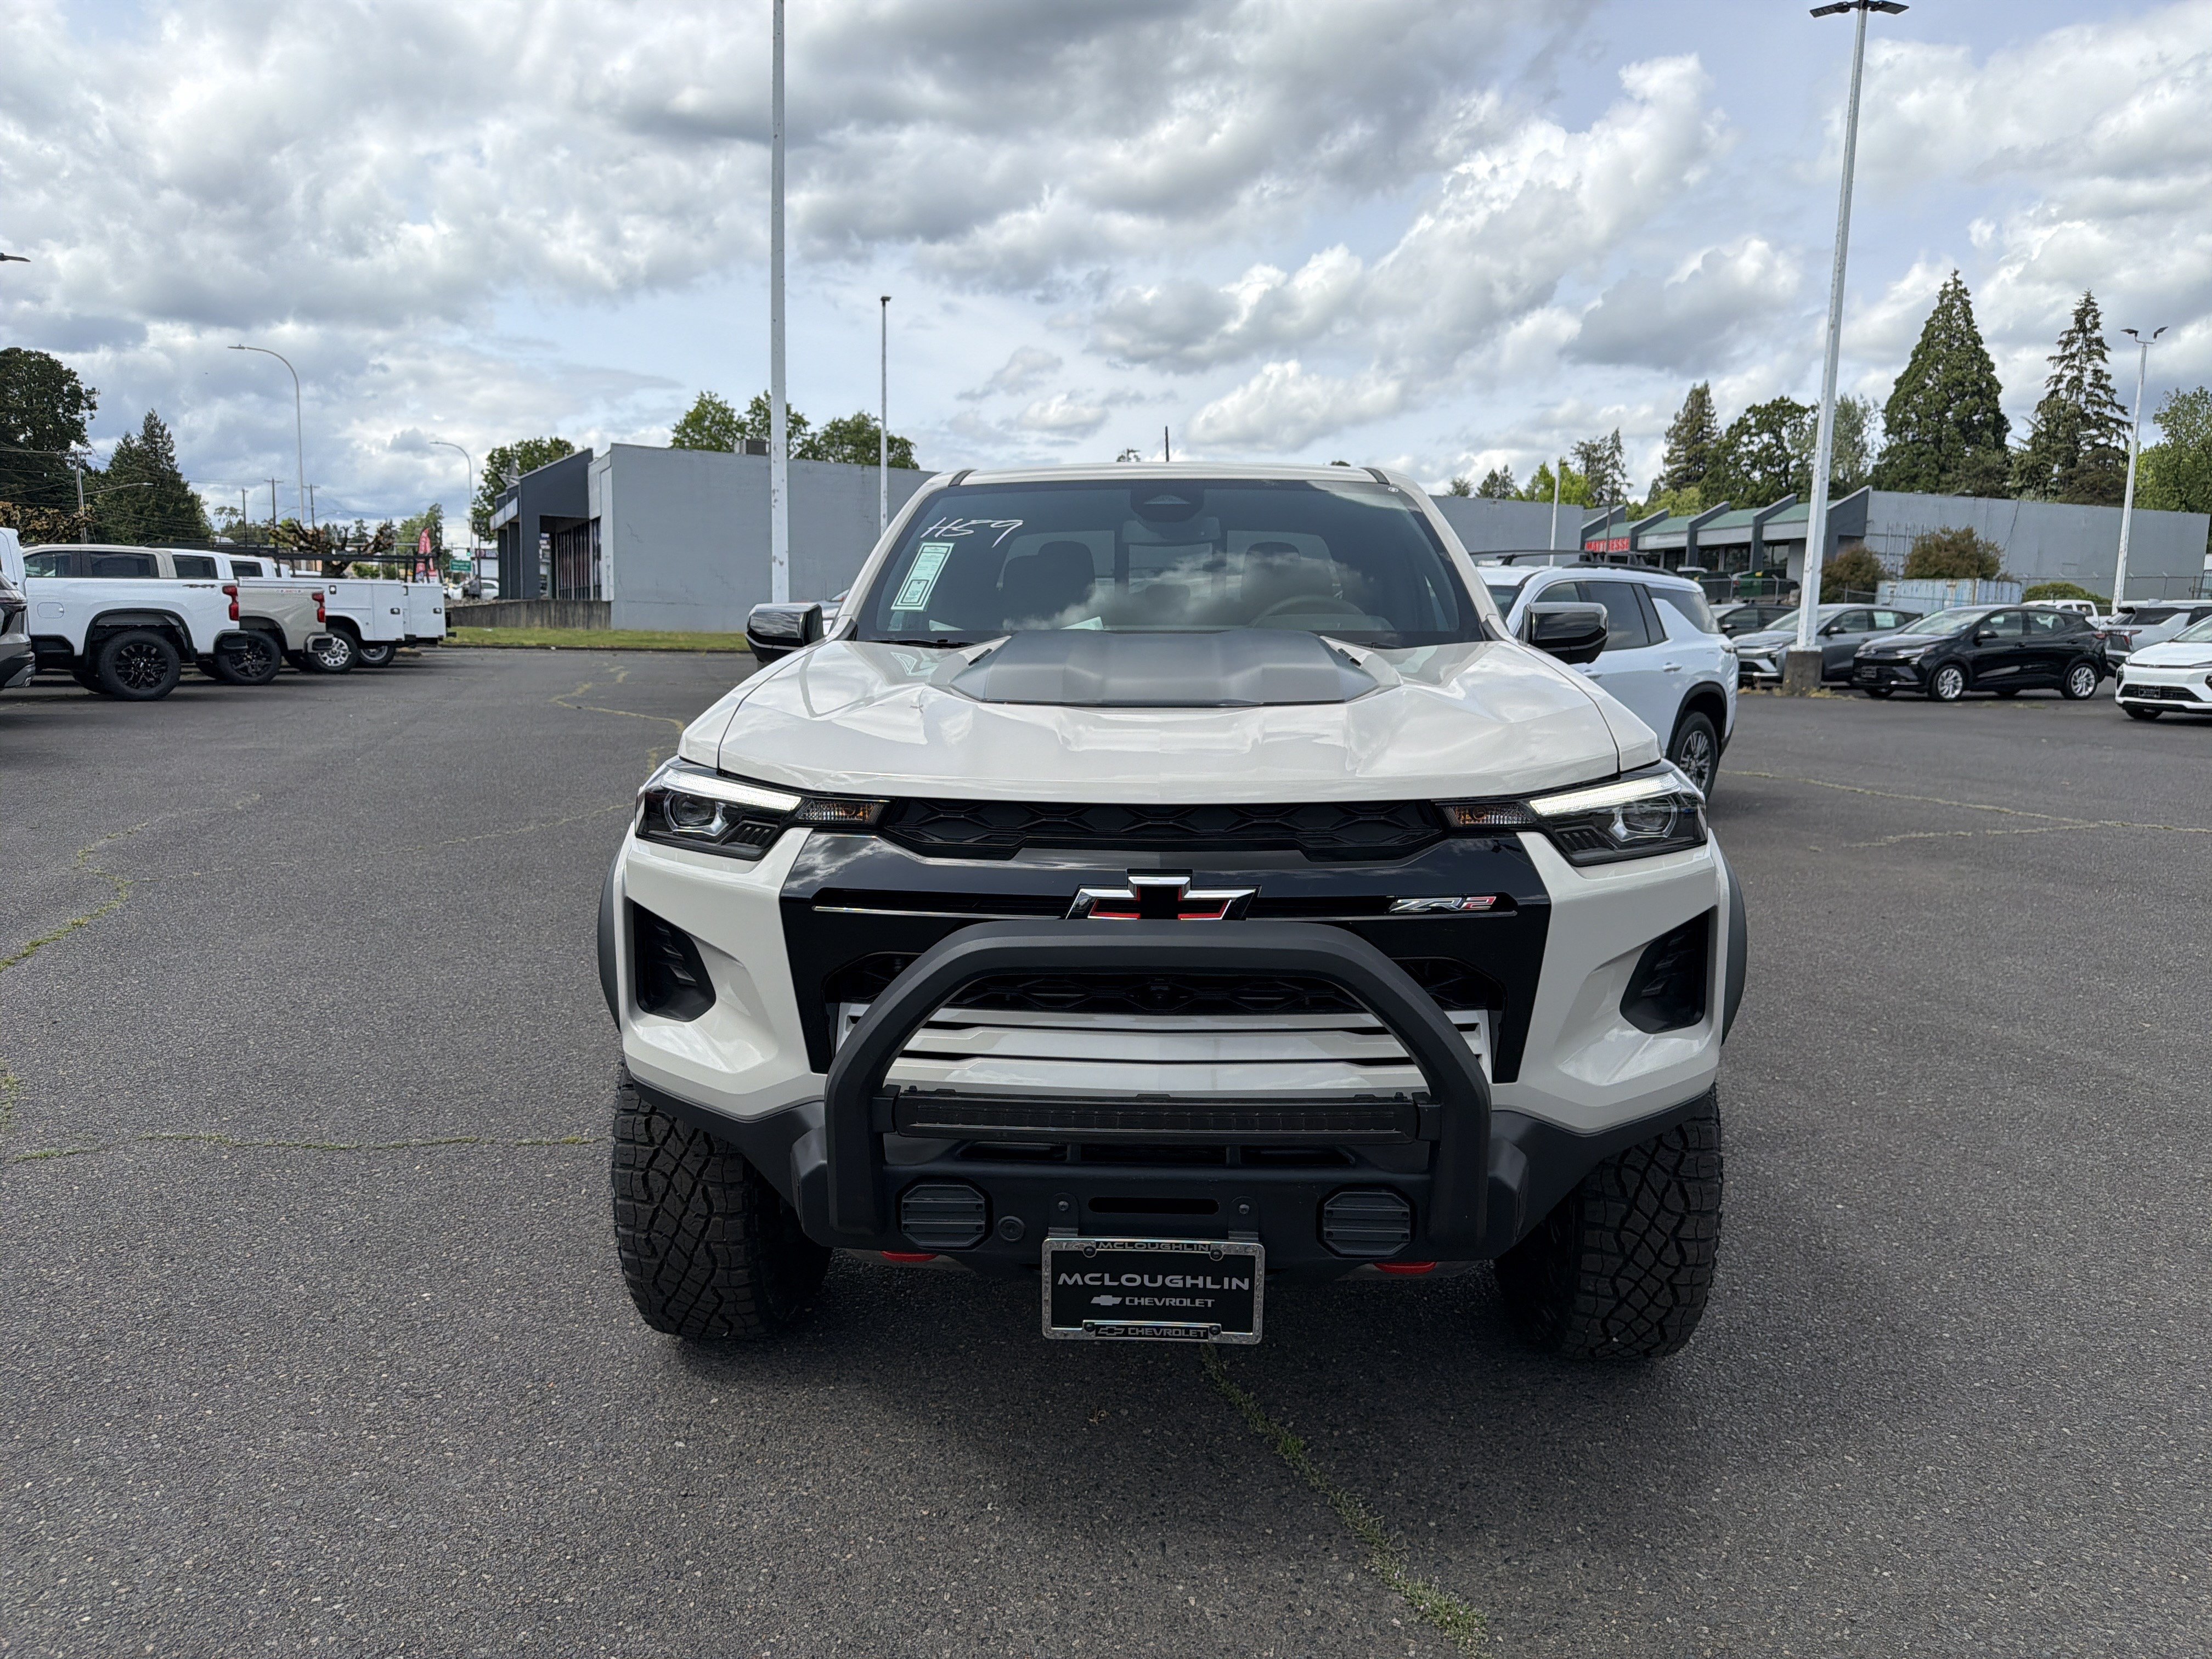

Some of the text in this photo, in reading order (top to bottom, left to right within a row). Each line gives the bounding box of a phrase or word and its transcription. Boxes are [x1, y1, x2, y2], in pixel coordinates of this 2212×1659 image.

[1390, 896, 1497, 913] ZR2
[1098, 1242, 1210, 1251] MCLOUGHLIN
[1057, 1273, 1249, 1290] MCLOUGHLIN
[1125, 1296, 1215, 1307] CHEVROLET
[1128, 1327, 1206, 1338] CHEVROLET
